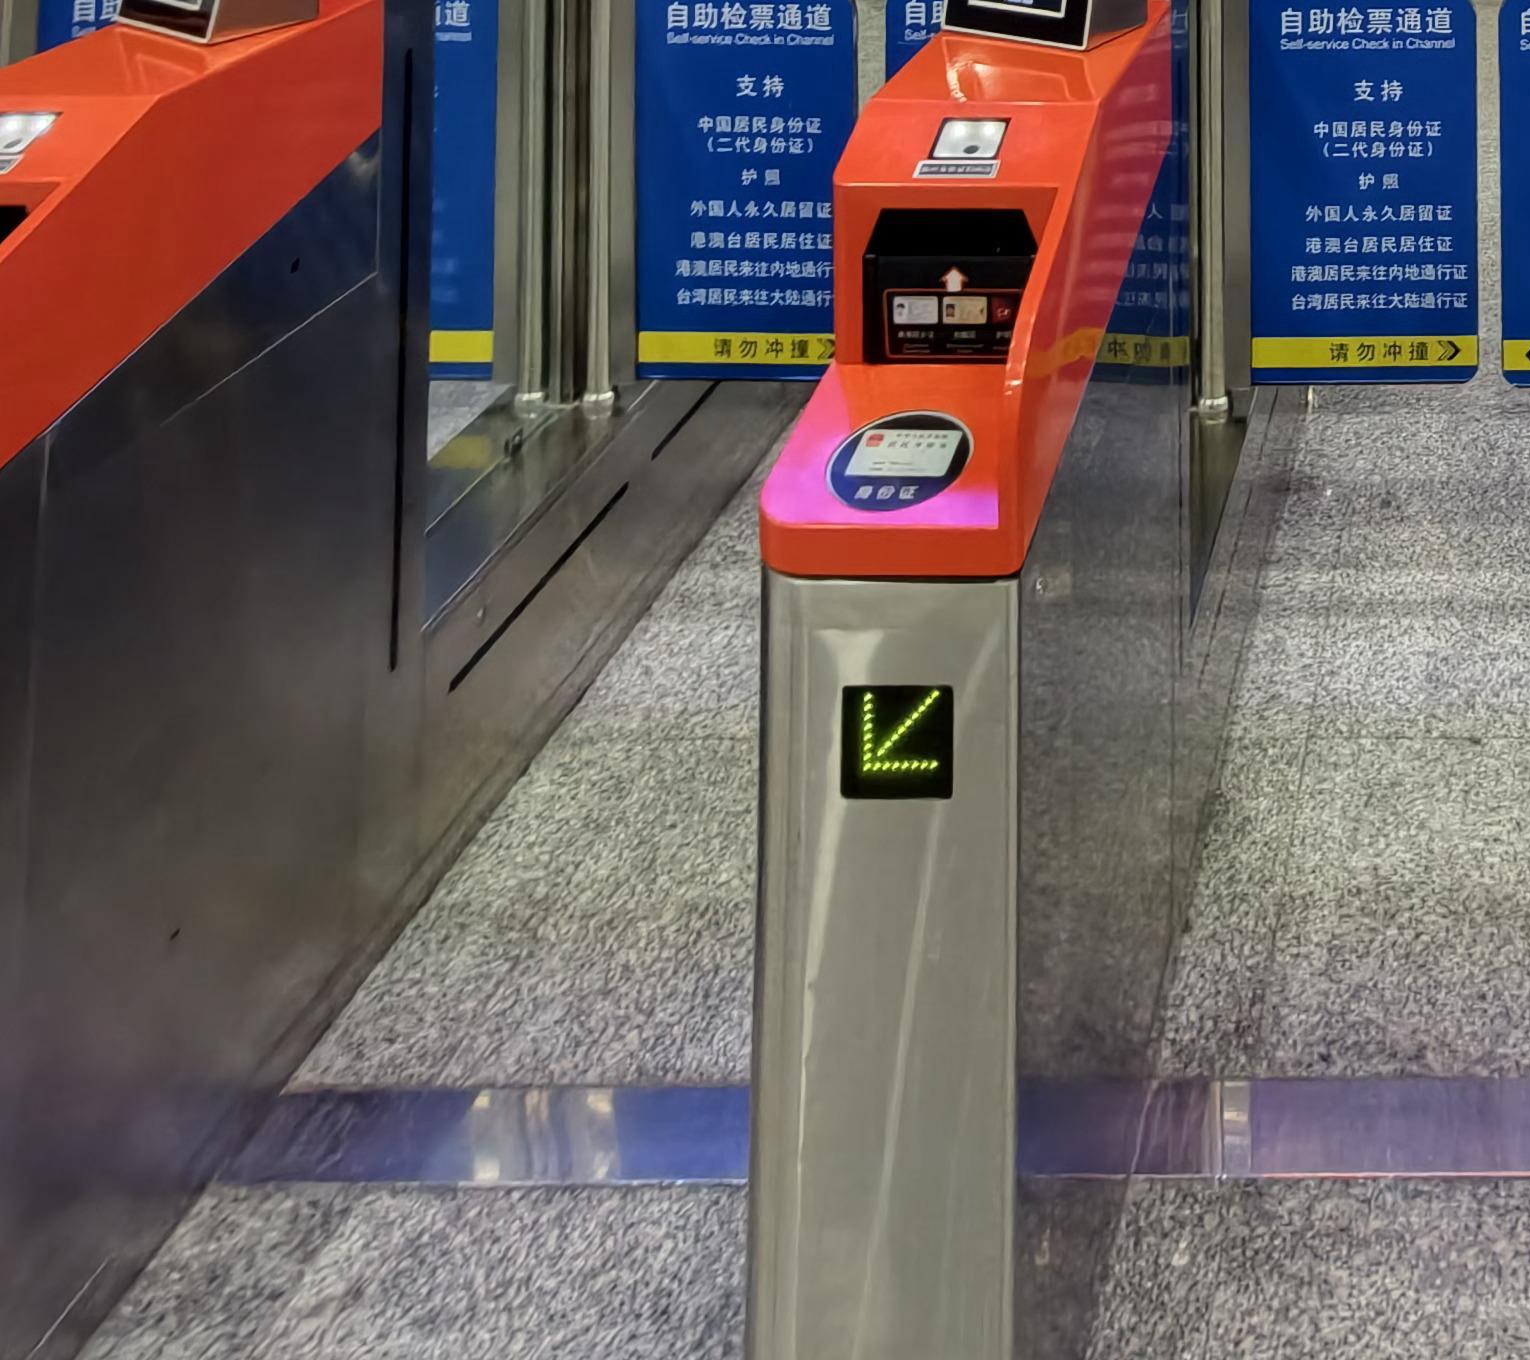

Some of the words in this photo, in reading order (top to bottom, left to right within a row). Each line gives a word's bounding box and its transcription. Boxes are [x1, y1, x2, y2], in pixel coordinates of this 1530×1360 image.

[667, 2, 832, 35] 自助检票通道
[1282, 8, 1452, 39] 自助检票通道
[737, 75, 784, 97] 支持
[1354, 80, 1403, 101] 支持
[698, 116, 821, 133] 中国居民身份证
[1314, 121, 1441, 138] 中国居民身份证
[1359, 173, 1399, 189] 护照
[1306, 205, 1452, 222] 外国人永久居留证
[1306, 236, 1453, 253] 港澳台居民居住证
[676, 261, 834, 278] 港澳居民来往内地通行
[1292, 264, 1468, 281] 港澳居民来往内地通行证
[677, 289, 834, 307] 台湾居民来往大陆通行
[1292, 293, 1467, 310] 台湾居民来往大陆通行证
[714, 337, 809, 359] 请勿冲撞
[1330, 341, 1429, 361] 请勿冲撞
